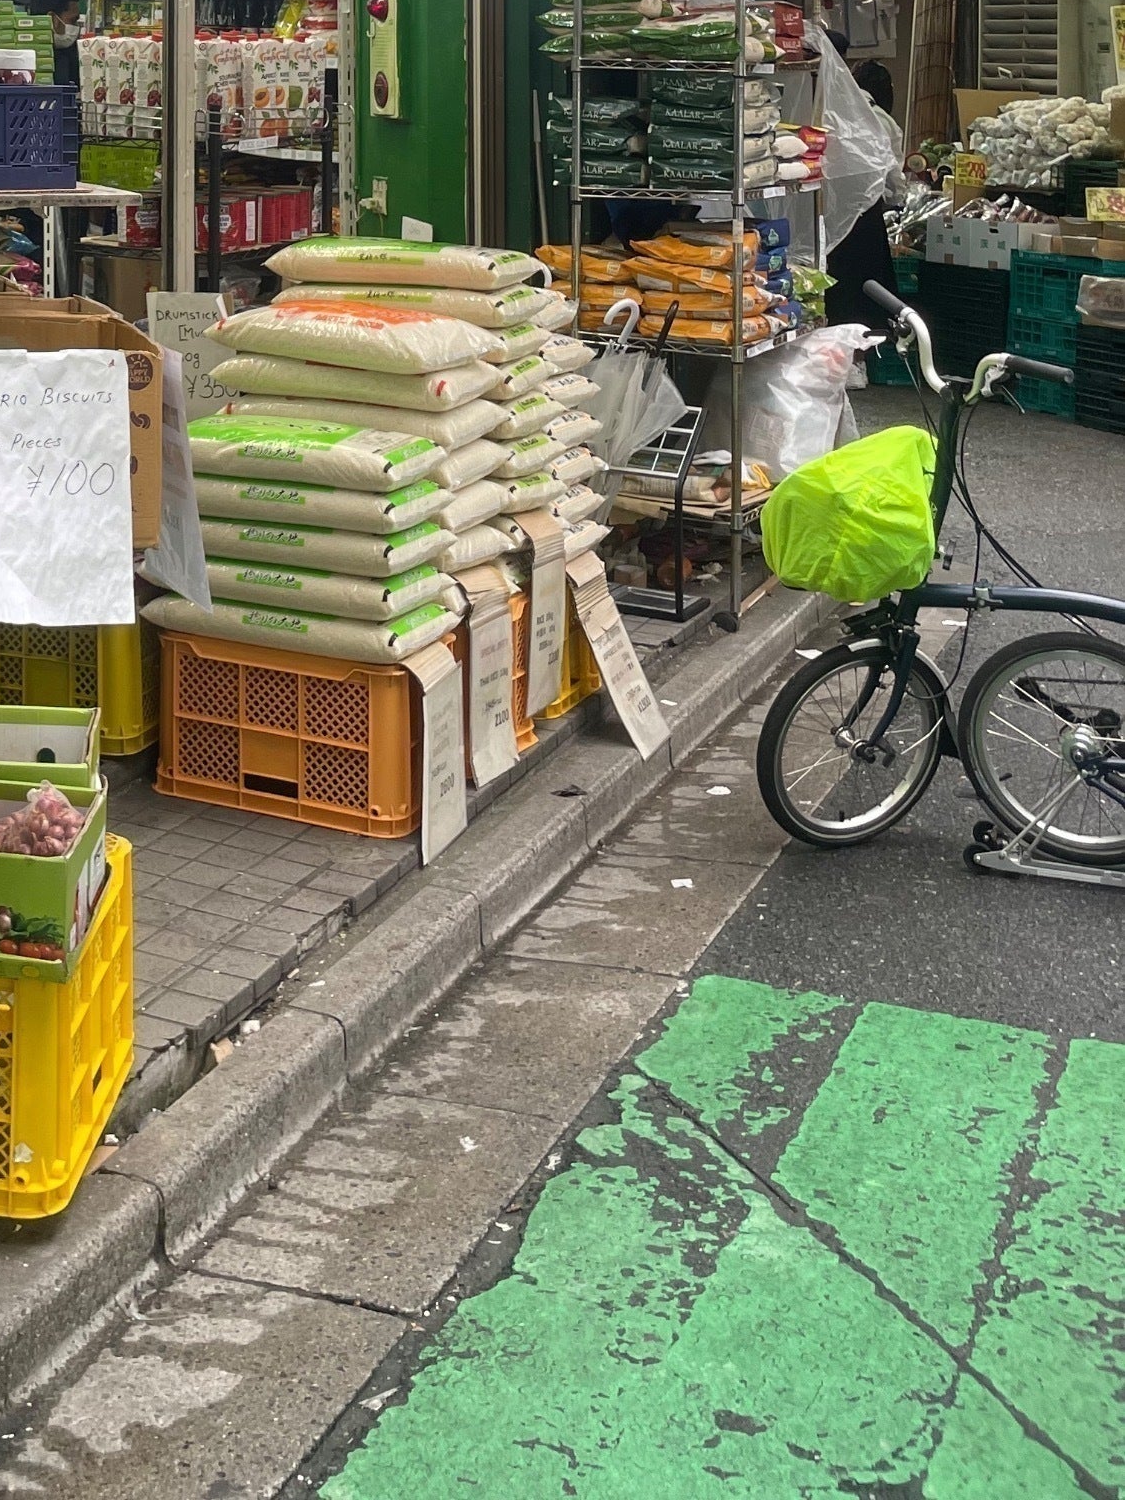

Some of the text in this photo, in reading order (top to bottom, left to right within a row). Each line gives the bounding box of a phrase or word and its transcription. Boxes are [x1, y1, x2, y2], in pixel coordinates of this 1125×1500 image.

[665, 108, 701, 118] KAALAR
[662, 139, 698, 150] KAALAR
[663, 170, 701, 179] KAALAR
[156, 310, 218, 321] DRUMSTICK
[27, 460, 115, 498] ¥100
